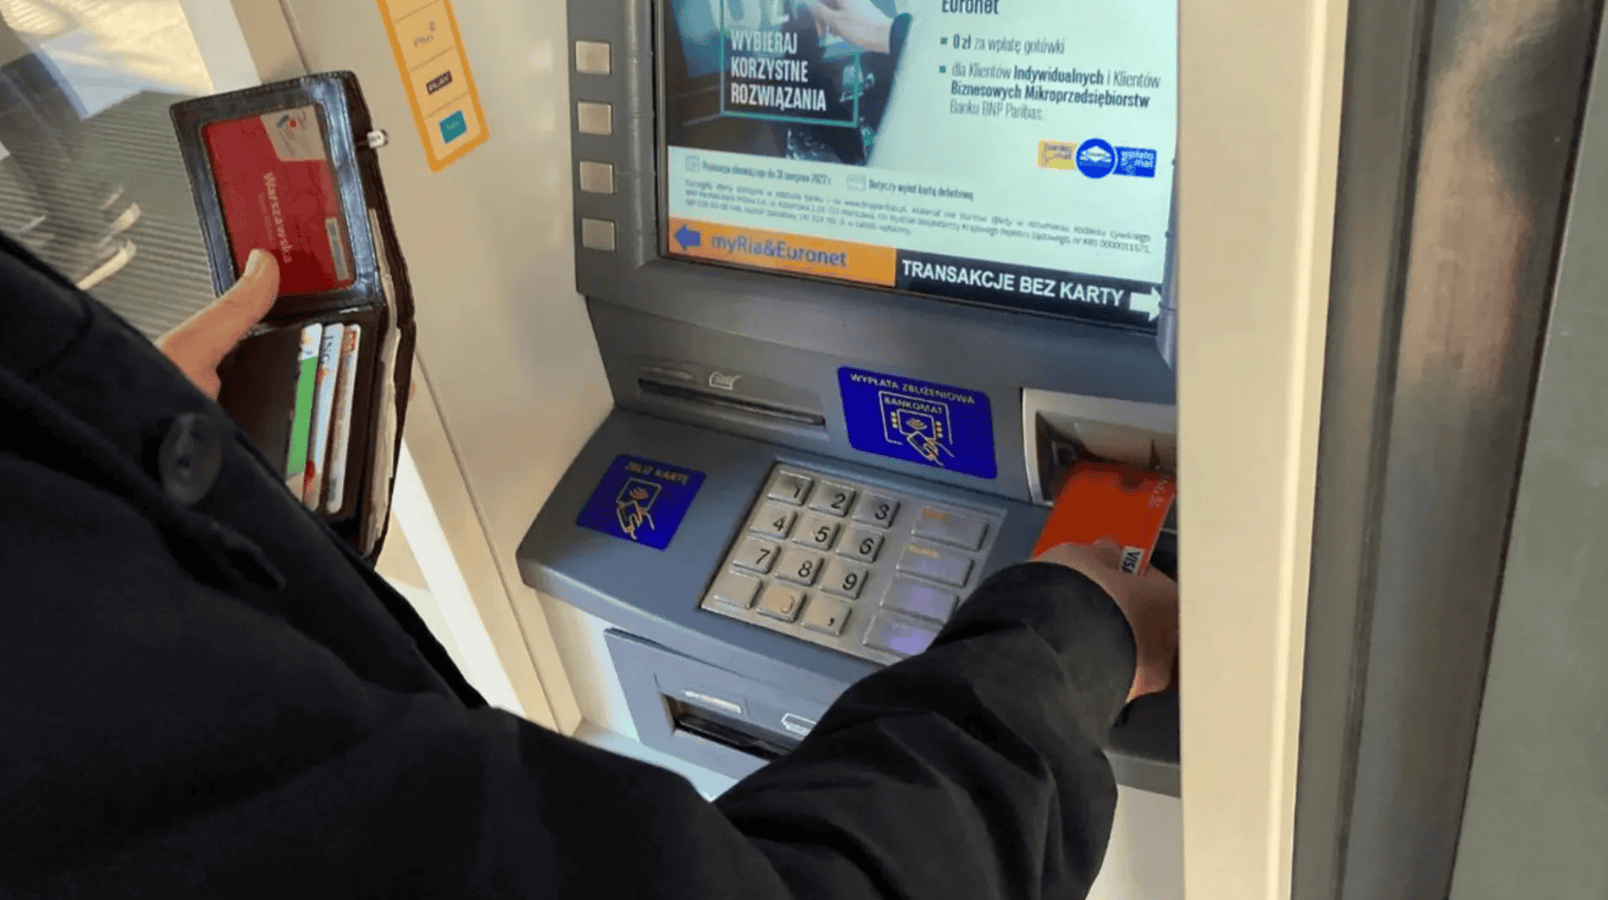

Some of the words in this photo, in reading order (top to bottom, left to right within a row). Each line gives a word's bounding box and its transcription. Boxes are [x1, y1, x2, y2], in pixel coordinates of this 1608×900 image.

[942, 0, 999, 15] Euronet
[730, 30, 798, 54] WYBIERAJ
[953, 34, 960, 49] 0
[961, 34, 971, 49] zł
[973, 38, 985, 50] za
[988, 36, 1022, 54] wpłatę
[1024, 37, 1066, 56] gotówki
[731, 57, 808, 82] KORZYSTNE
[968, 61, 1012, 80] Klientów
[1014, 65, 1104, 87] Indywidualnych
[1113, 70, 1161, 89] Klientów
[731, 83, 827, 111] ROZWIĄZANIA
[951, 80, 1022, 101] Biznesowych
[1024, 85, 1150, 108] Mikroprzedsiębiorstw
[950, 99, 980, 116] Banku
[981, 101, 1003, 117] BNP
[711, 234, 848, 267] myRia&Euronet
[902, 258, 1015, 291] TRANSAKCJE
[1019, 276, 1056, 297] BEZ
[1060, 282, 1124, 306] KARTY
[884, 396, 943, 414] BANKOMAT
[830, 493, 846, 510] 2
[874, 503, 891, 520] 3
[772, 517, 785, 532] 4
[814, 526, 829, 543] 5
[858, 537, 875, 555] 6
[755, 548, 770, 565] 7
[797, 560, 813, 578] 8
[842, 573, 858, 591] 9
